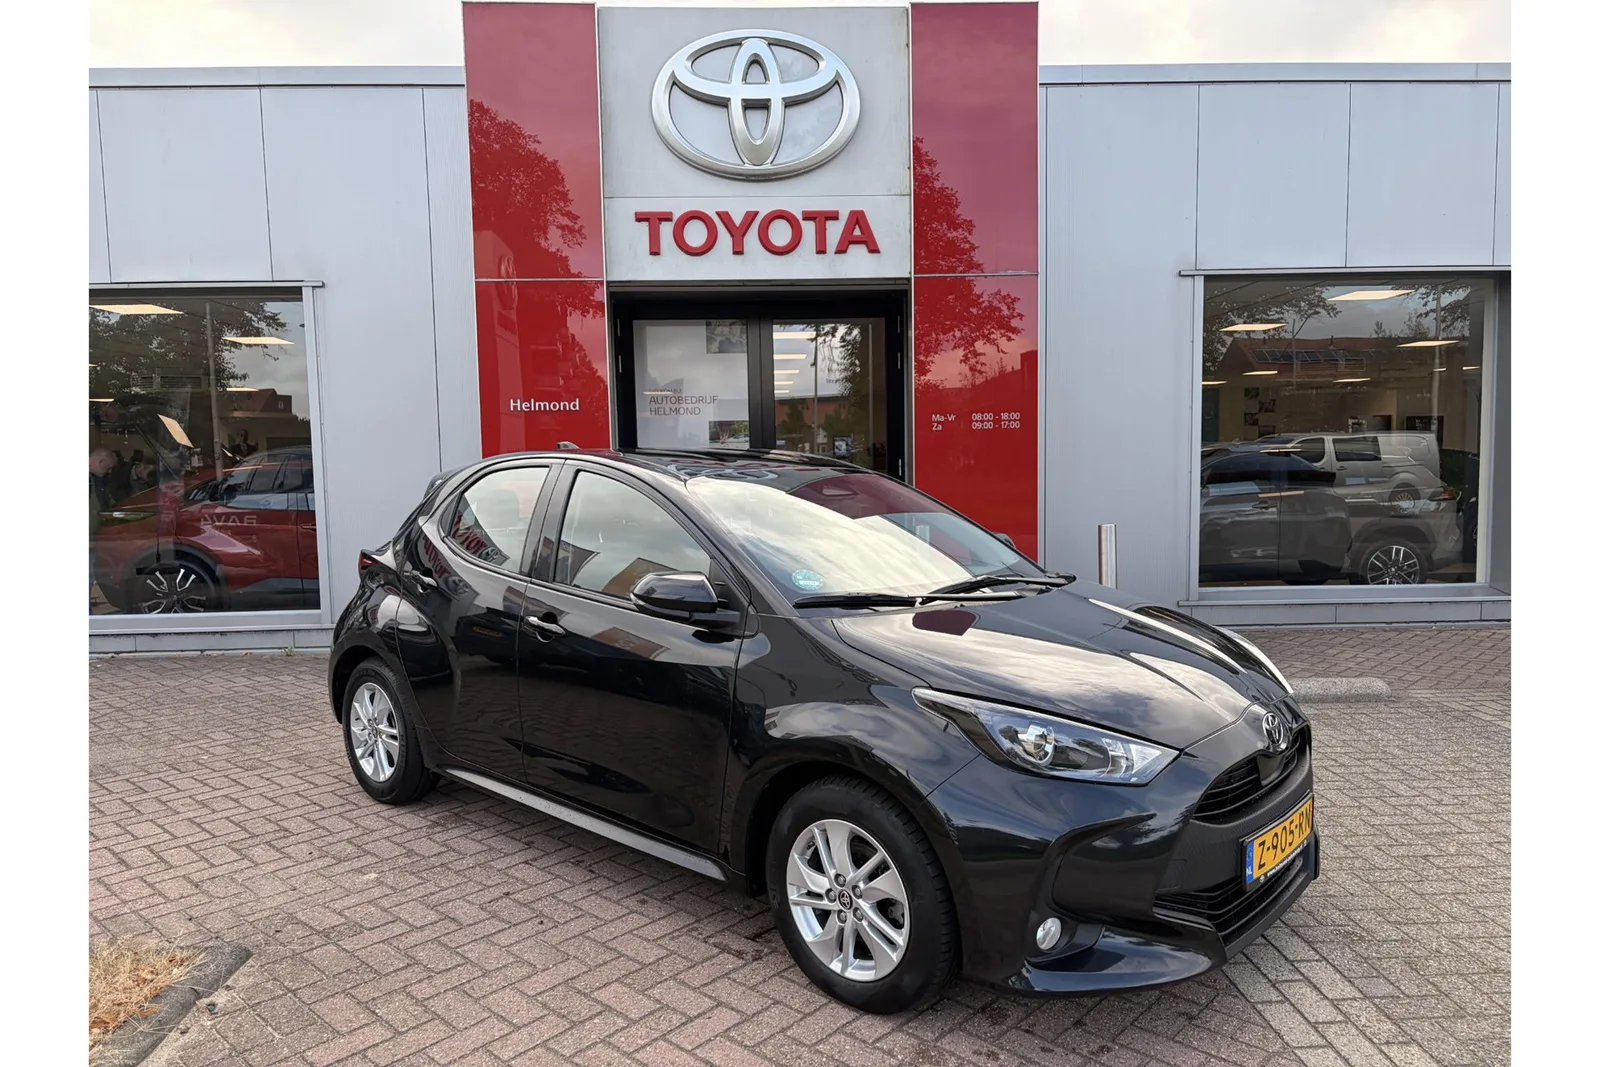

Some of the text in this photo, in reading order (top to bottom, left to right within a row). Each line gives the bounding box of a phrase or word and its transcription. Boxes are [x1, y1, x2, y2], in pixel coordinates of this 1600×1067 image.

[634, 209, 881, 256] TOYOTA
[510, 398, 580, 411] Helmond
[649, 395, 718, 405] AUTOBEDRIJF
[649, 406, 702, 416] HELMOND
[931, 414, 956, 422] Ma-Vr
[971, 412, 994, 421] 08:00
[1000, 412, 1021, 420] 18:00
[932, 422, 942, 431] Za
[971, 421, 994, 430] 09:00
[1000, 420, 1021, 429] 17:00
[1257, 803, 1312, 871] Z-905-RN
